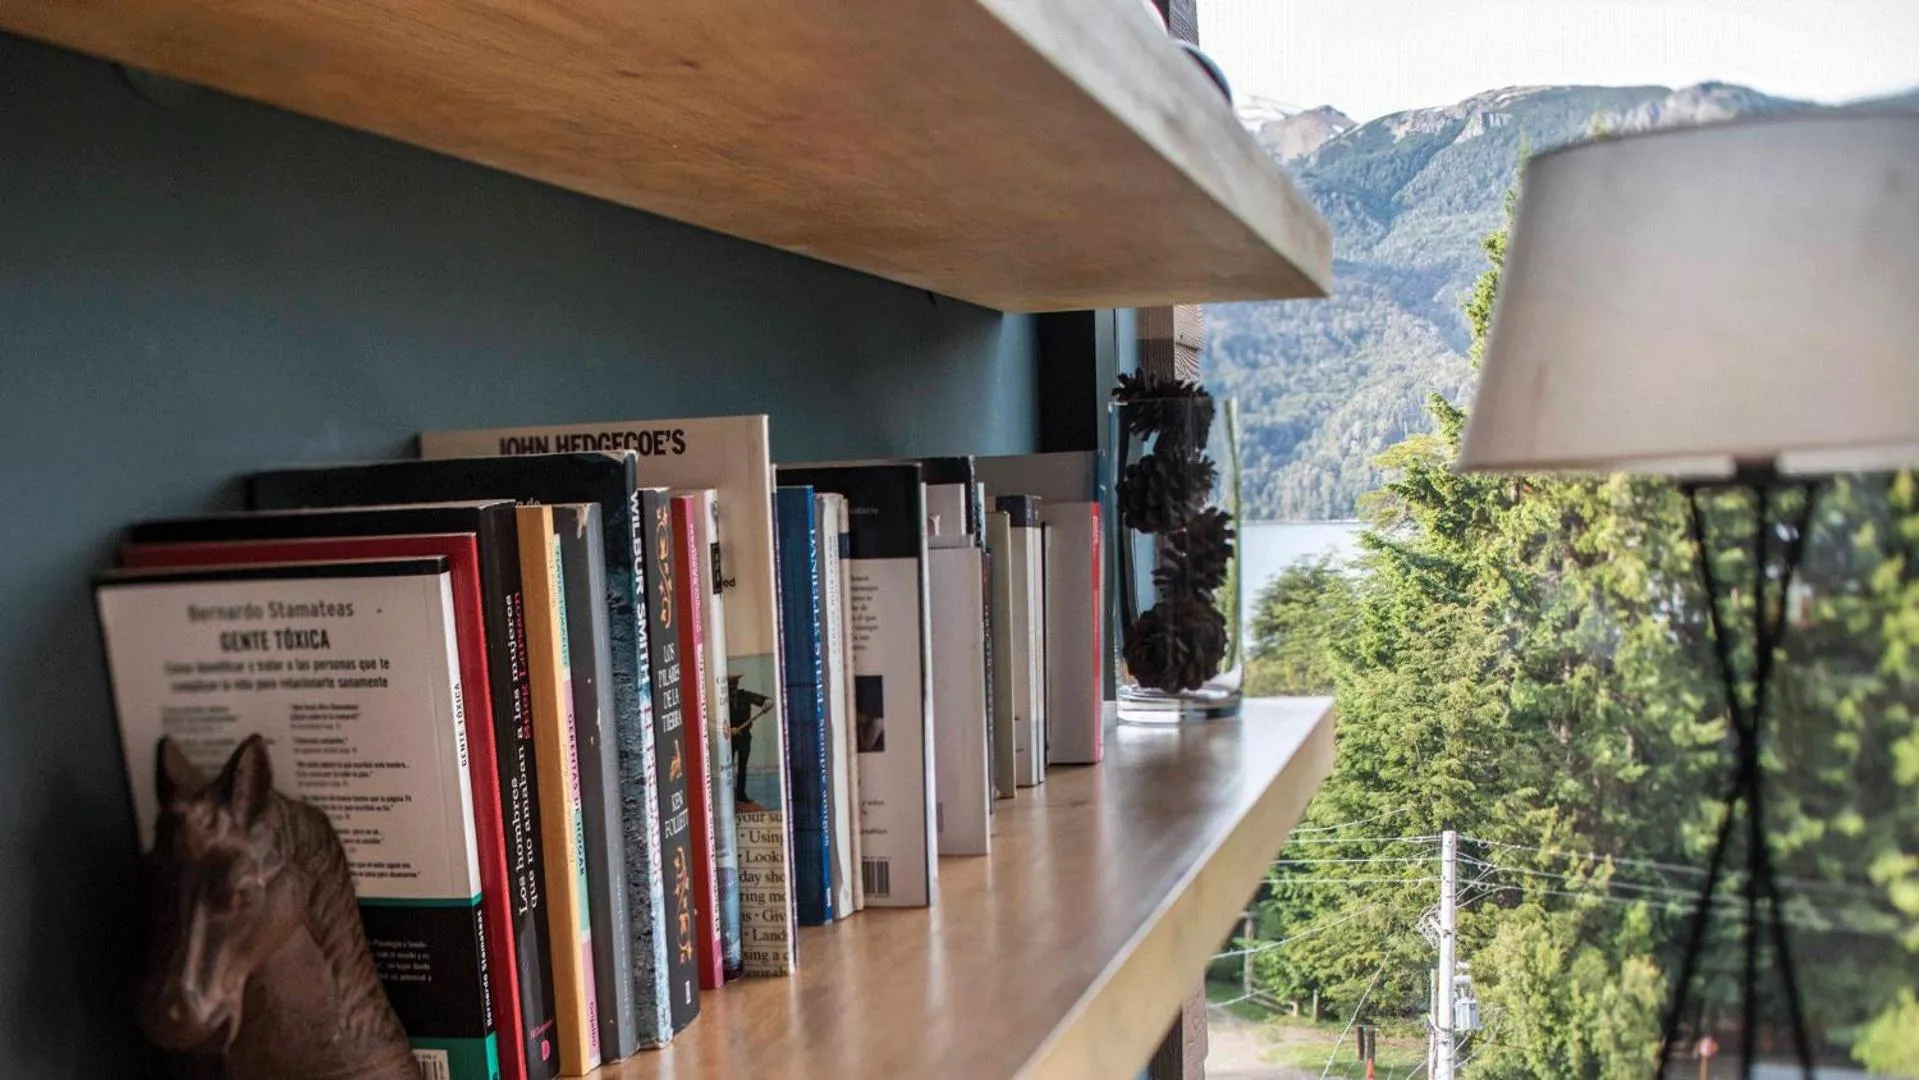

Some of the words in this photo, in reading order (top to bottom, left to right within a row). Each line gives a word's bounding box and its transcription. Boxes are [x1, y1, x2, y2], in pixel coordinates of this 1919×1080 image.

[556, 429, 686, 455] HEDGECOE'S
[630, 491, 644, 594] WILBUR
[637, 603, 650, 684] SMITH
[810, 529, 820, 637] DANIELLE
[268, 600, 354, 620] Stamateas
[220, 630, 269, 652] GENTE
[274, 627, 330, 650] TÓXICA
[505, 594, 519, 682] mujeres
[314, 659, 356, 674] personas
[359, 658, 376, 673] que
[379, 656, 389, 670] te
[663, 643, 675, 663] LOS
[658, 664, 680, 688] PILARES
[454, 683, 464, 725] TÓXICA
[513, 688, 522, 721] las
[661, 709, 683, 733] TIERRA
[458, 731, 467, 767] GENTE
[518, 745, 531, 832] amaban
[671, 789, 684, 811] KEN
[511, 777, 525, 873] hombres
[736, 813, 765, 826] your
[769, 813, 783, 823] su
[526, 838, 534, 865] no
[529, 870, 538, 908] que
[740, 871, 761, 886] day
[765, 871, 786, 882] sho
[518, 876, 527, 916] Los
[740, 891, 767, 904] ring
[762, 909, 786, 921] Giv
[753, 928, 787, 942] Land
[744, 950, 769, 963] sing
